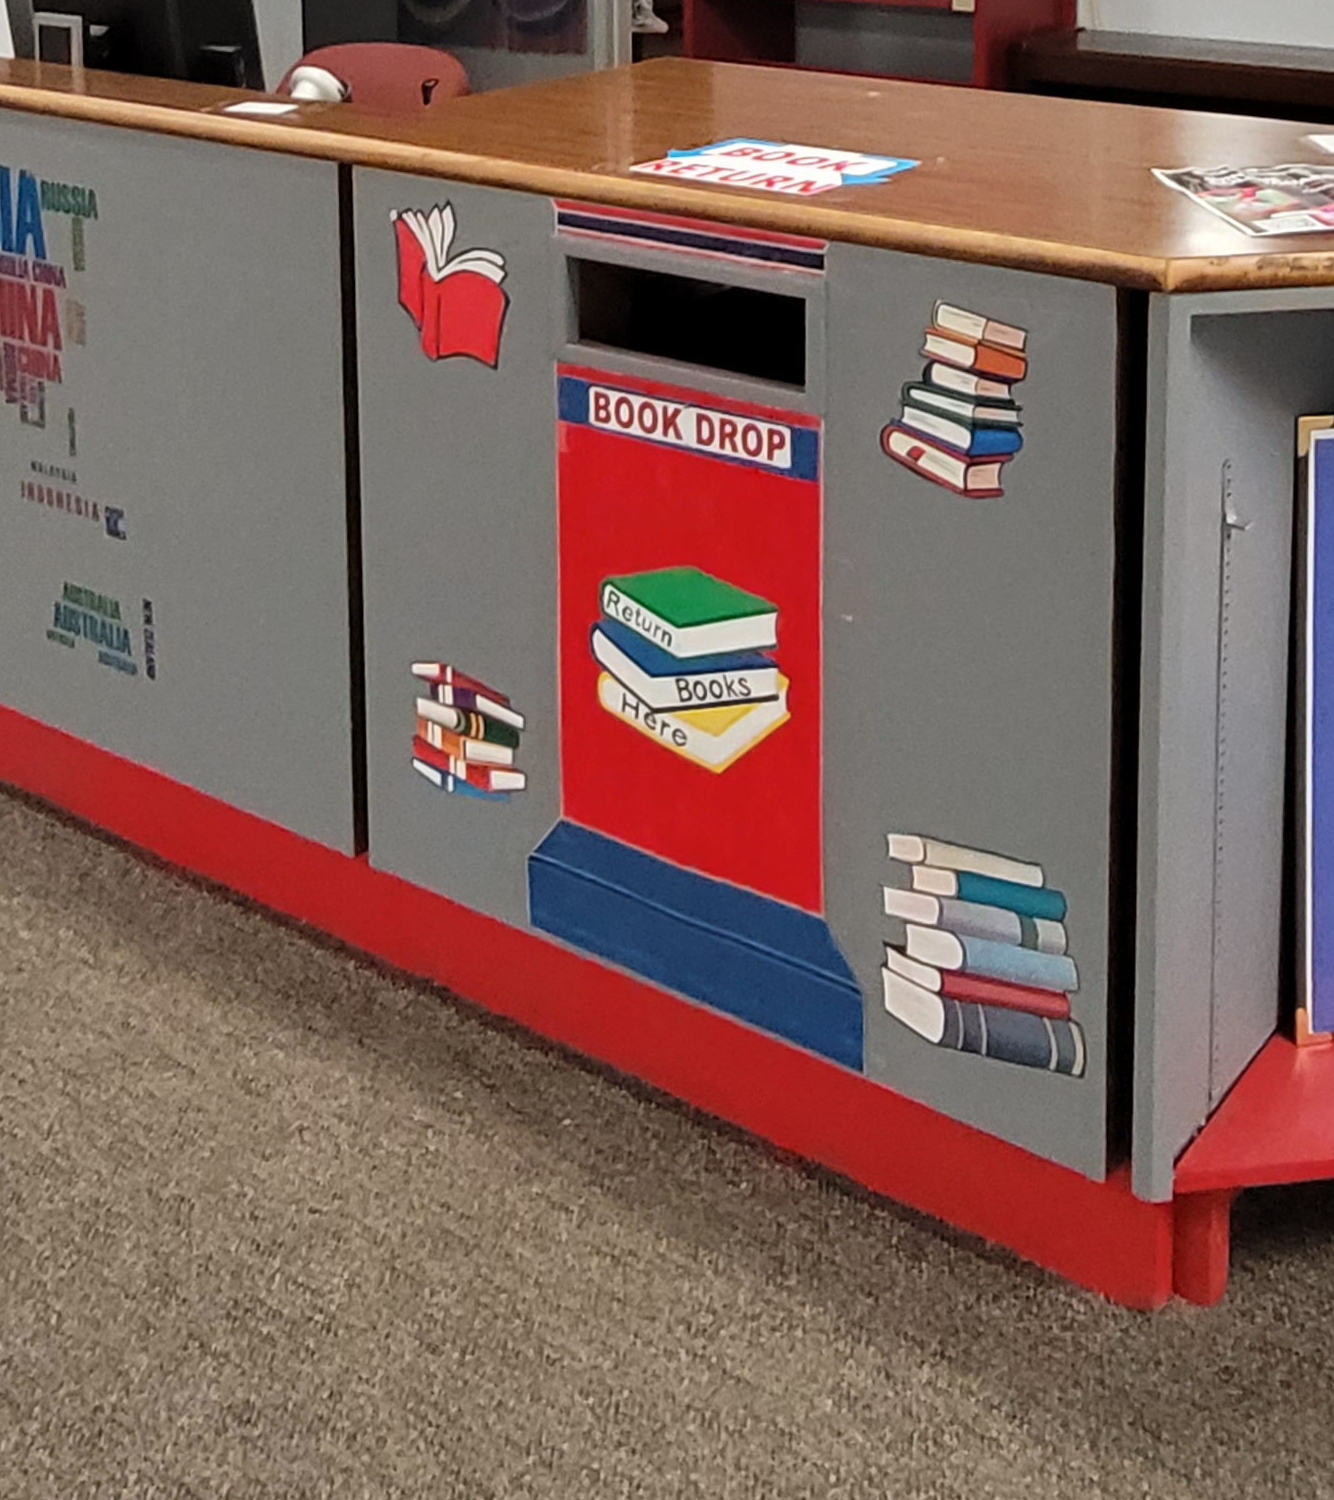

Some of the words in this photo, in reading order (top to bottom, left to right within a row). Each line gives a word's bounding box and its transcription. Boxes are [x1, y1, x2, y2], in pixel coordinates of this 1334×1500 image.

[645, 160, 837, 194] RETURN
[719, 147, 870, 172] BOOK
[40, 180, 98, 220] RUSSIA
[593, 390, 683, 440] BOOK
[695, 412, 787, 461] DROP
[20, 479, 100, 522] INDONESIA
[53, 601, 132, 657] AUSTRALIA
[605, 589, 673, 647] Return
[675, 674, 752, 702] Books
[620, 692, 688, 747] Here
